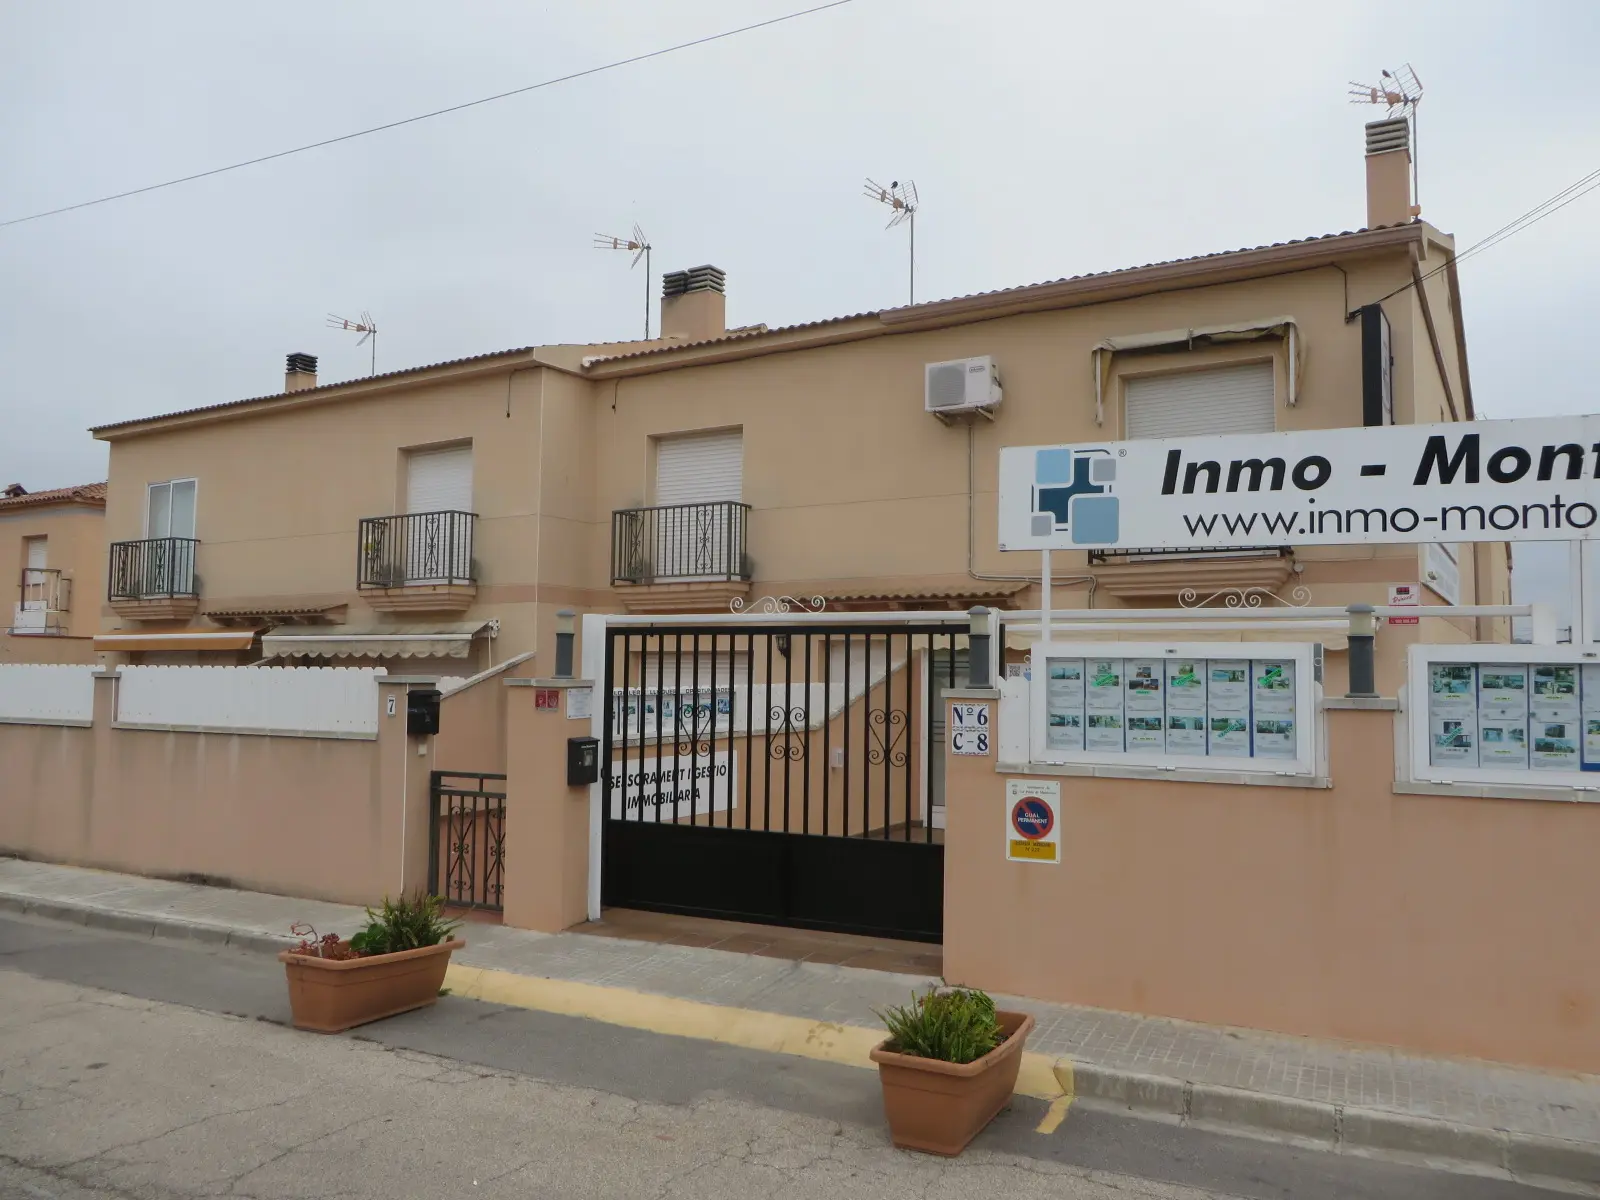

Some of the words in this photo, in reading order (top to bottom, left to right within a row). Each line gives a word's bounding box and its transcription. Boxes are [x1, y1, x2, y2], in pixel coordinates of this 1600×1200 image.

[1161, 449, 1332, 495] Inmo
[1183, 494, 1598, 537] www.inmo-monto
[389, 699, 394, 712] 7
